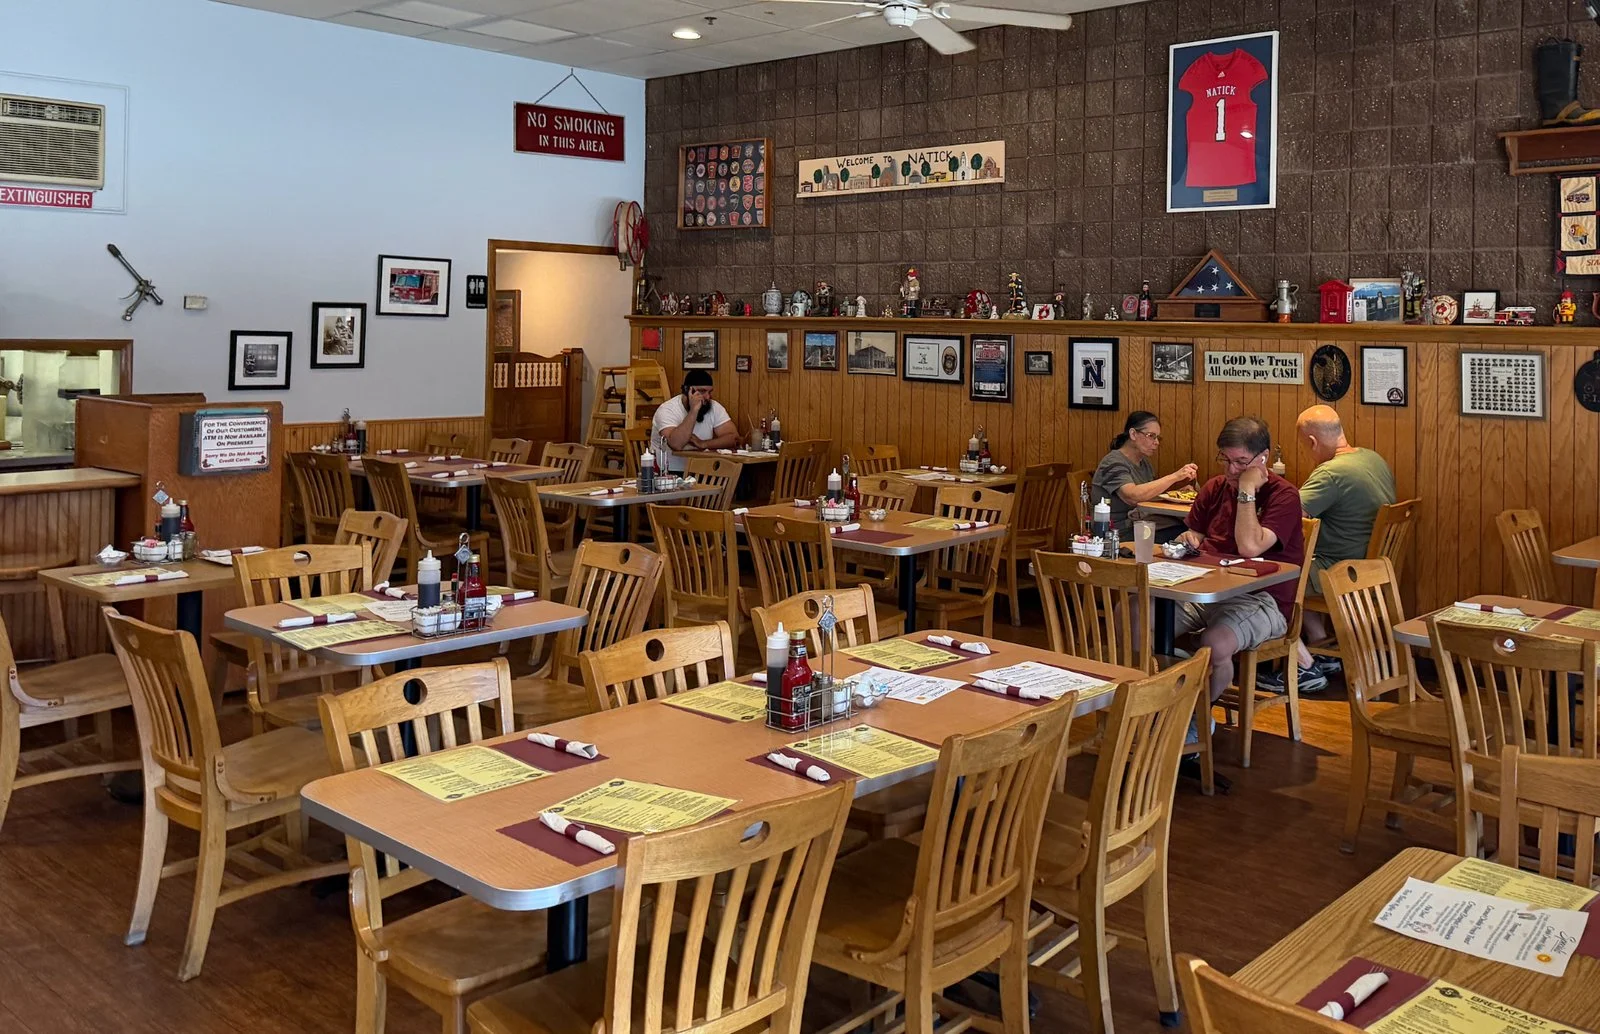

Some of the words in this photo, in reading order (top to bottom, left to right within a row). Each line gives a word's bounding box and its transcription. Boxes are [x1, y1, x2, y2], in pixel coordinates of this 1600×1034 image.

[1205, 86, 1236, 98] NATICK
[527, 112, 547, 128] NO
[554, 116, 615, 136] SMOKING
[1215, 99, 1226, 142] 1
[539, 135, 548, 146] IN
[553, 136, 575, 149] THIS
[579, 139, 605, 152] AREA
[908, 151, 953, 164] NATICK
[0, 188, 90, 206] EXTINGUISHER
[1208, 355, 1219, 364] In
[1222, 355, 1246, 365] GOD
[1250, 356, 1264, 366] We
[1267, 356, 1298, 367] Trust
[1081, 357, 1106, 389] N
[1209, 366, 1221, 376] All
[1223, 366, 1251, 377] others
[1253, 370, 1269, 380] pay
[1273, 368, 1297, 378] CASH
[1471, 996, 1547, 1025] BREAKFAST
